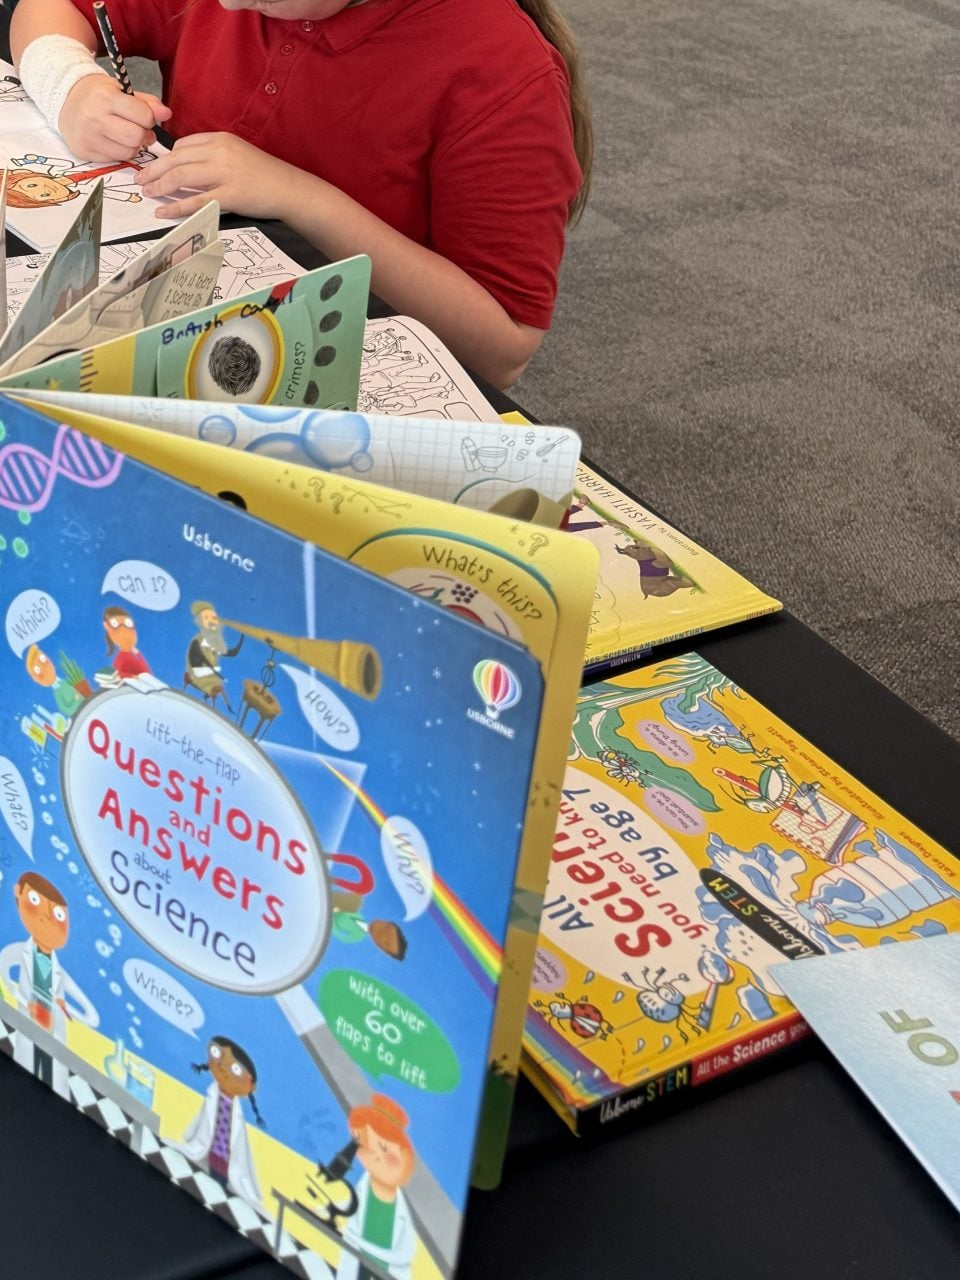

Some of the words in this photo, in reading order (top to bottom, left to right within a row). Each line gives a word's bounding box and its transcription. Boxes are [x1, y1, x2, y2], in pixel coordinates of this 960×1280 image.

[285, 341, 307, 400] crimes?
[612, 497, 658, 532] VASHTI
[182, 523, 255, 572] Usborne
[423, 544, 493, 584] What's
[497, 577, 543, 621] this?
[11, 597, 51, 641] Which?
[603, 646, 640, 659] SCIENCE
[640, 640, 657, 650] AND
[657, 626, 705, 645] ADVENTURE
[465, 707, 515, 740] USBORNE
[145, 718, 241, 786] Lift-the-flap
[0, 772, 29, 832] What?
[87, 719, 308, 876] Questions
[562, 788, 591, 802] 7
[829, 776, 842, 789] by
[839, 786, 886, 821] Illustrated
[168, 810, 212, 848] and
[559, 801, 584, 826] kn
[590, 801, 642, 843] age
[97, 787, 285, 931] Answers
[582, 828, 606, 850] to
[134, 851, 173, 886] about
[393, 831, 426, 897] Why?
[599, 851, 661, 898] need
[638, 846, 678, 882] by
[109, 850, 257, 977] Science
[543, 894, 594, 931] All
[551, 832, 672, 958] Scien
[708, 877, 759, 917] STEM
[657, 902, 709, 939] you
[133, 967, 194, 1019] Where?
[364, 1009, 403, 1046] 60
[390, 1005, 426, 1035] over
[879, 1008, 959, 1067] OF
[336, 1015, 371, 1053] flaps
[377, 1042, 396, 1066] to
[399, 1059, 427, 1090] lift
[600, 1096, 645, 1123] Usborne
[646, 1067, 688, 1102] STEM
[696, 1063, 711, 1078] All
[713, 1055, 730, 1071] the
[732, 1028, 787, 1063] Science
